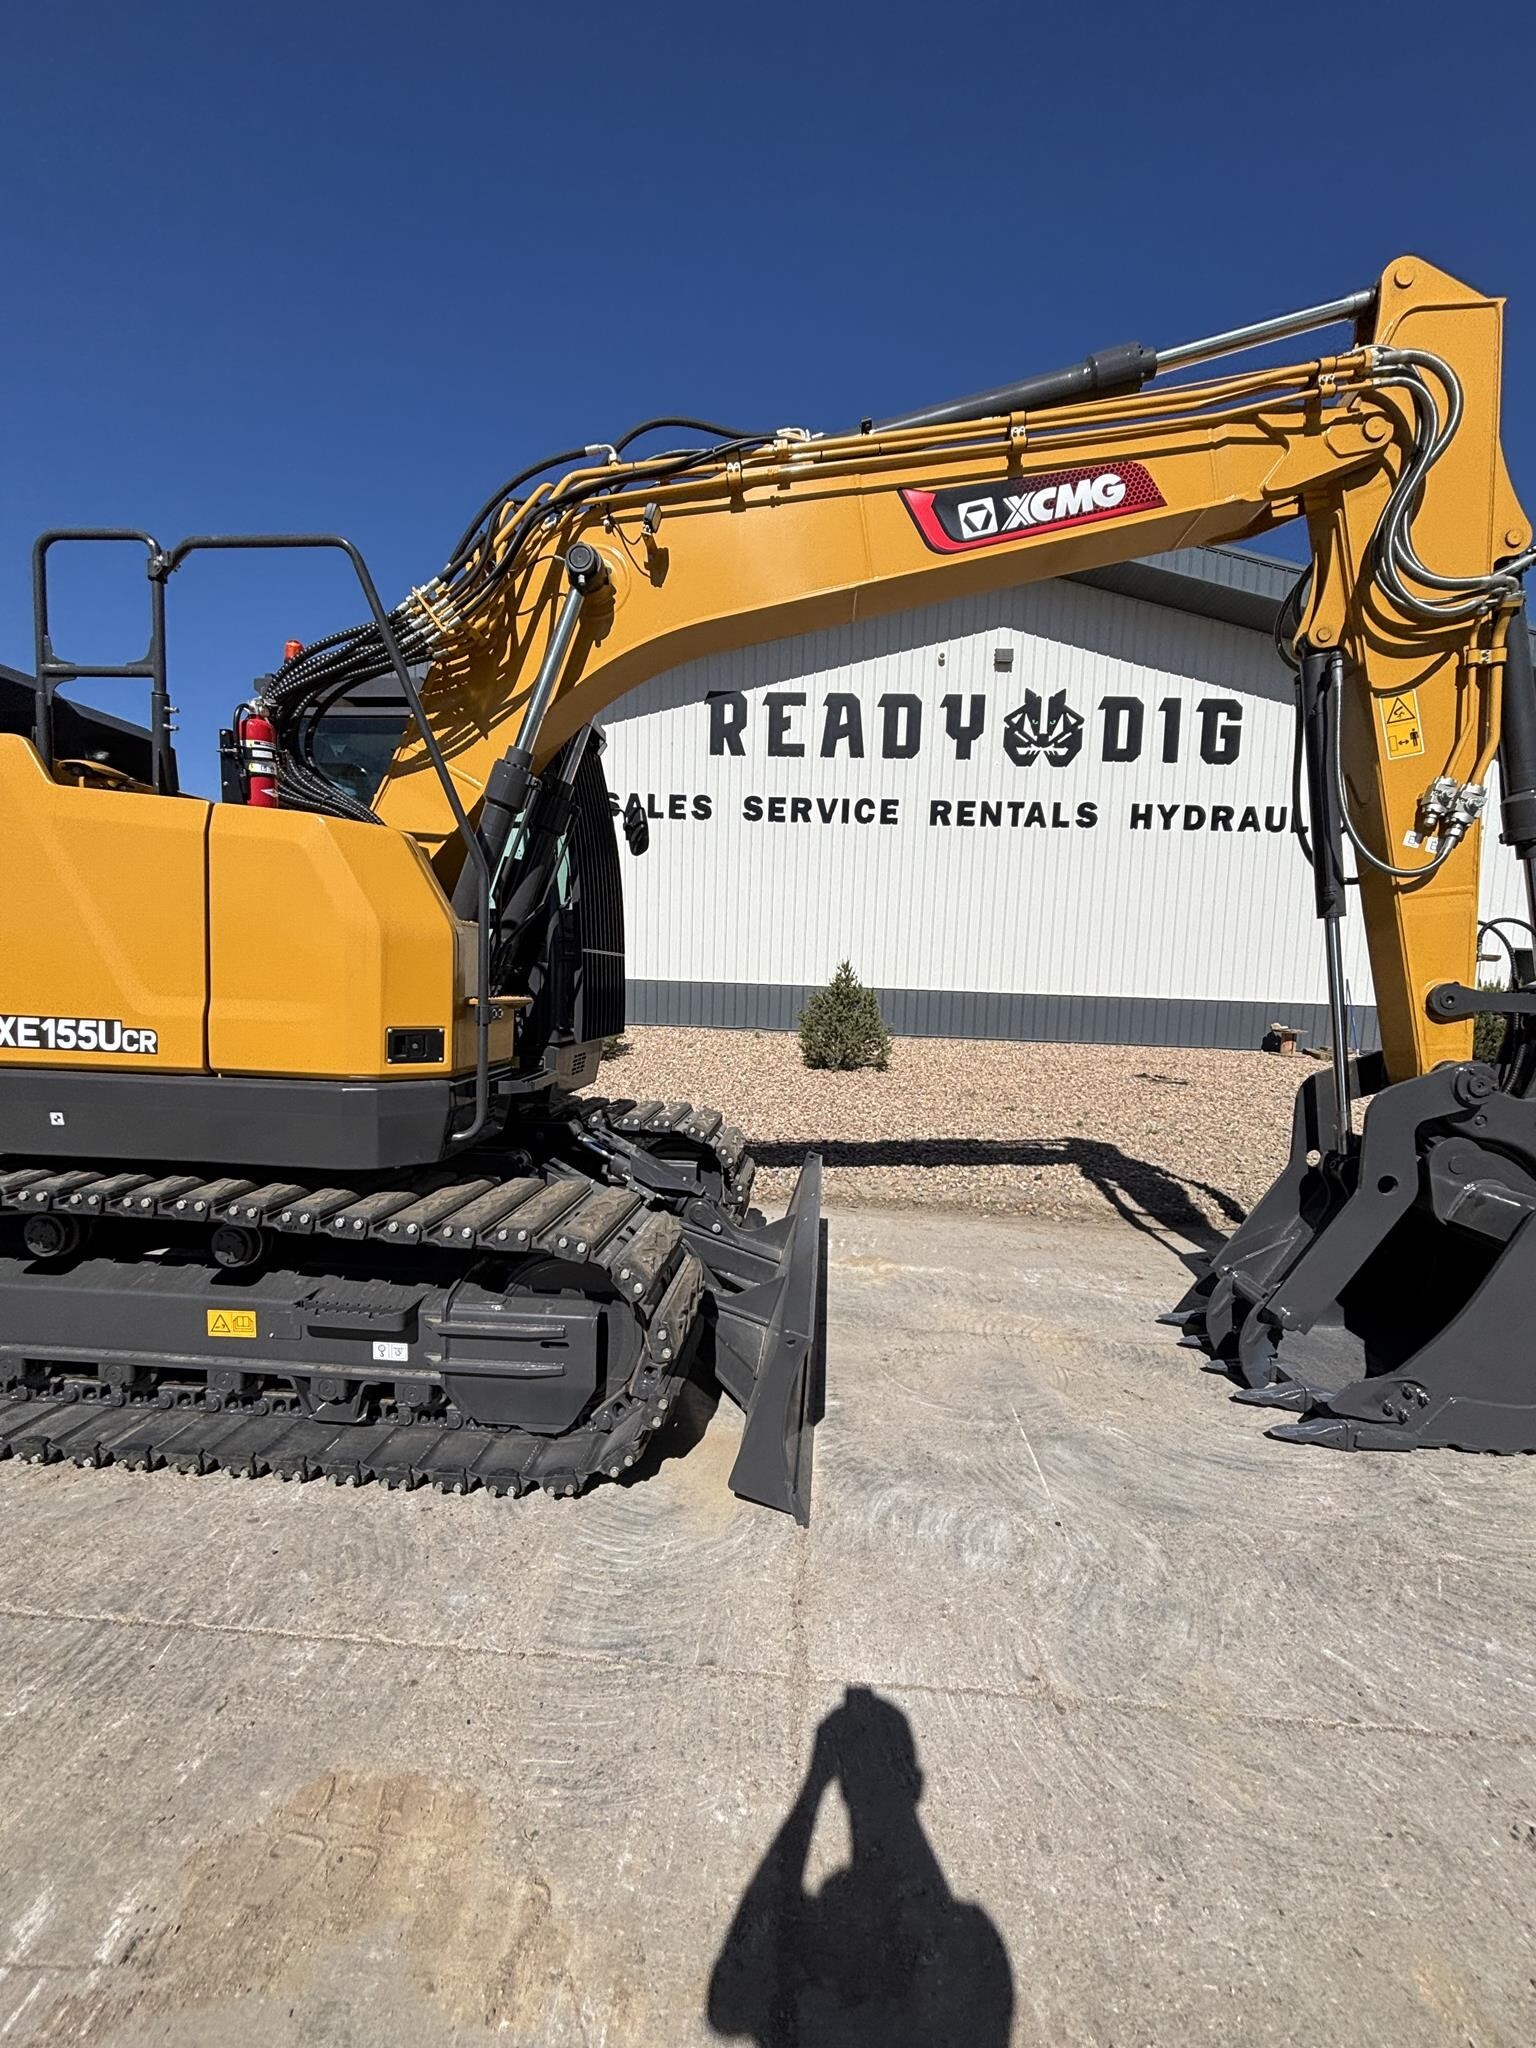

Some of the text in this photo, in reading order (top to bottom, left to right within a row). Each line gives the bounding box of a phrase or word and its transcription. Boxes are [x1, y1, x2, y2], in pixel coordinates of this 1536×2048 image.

[1000, 473, 1126, 531] XCMG
[704, 690, 1243, 766] READY DIG
[742, 795, 900, 826] SERVICE
[929, 800, 1098, 829] RENTALS
